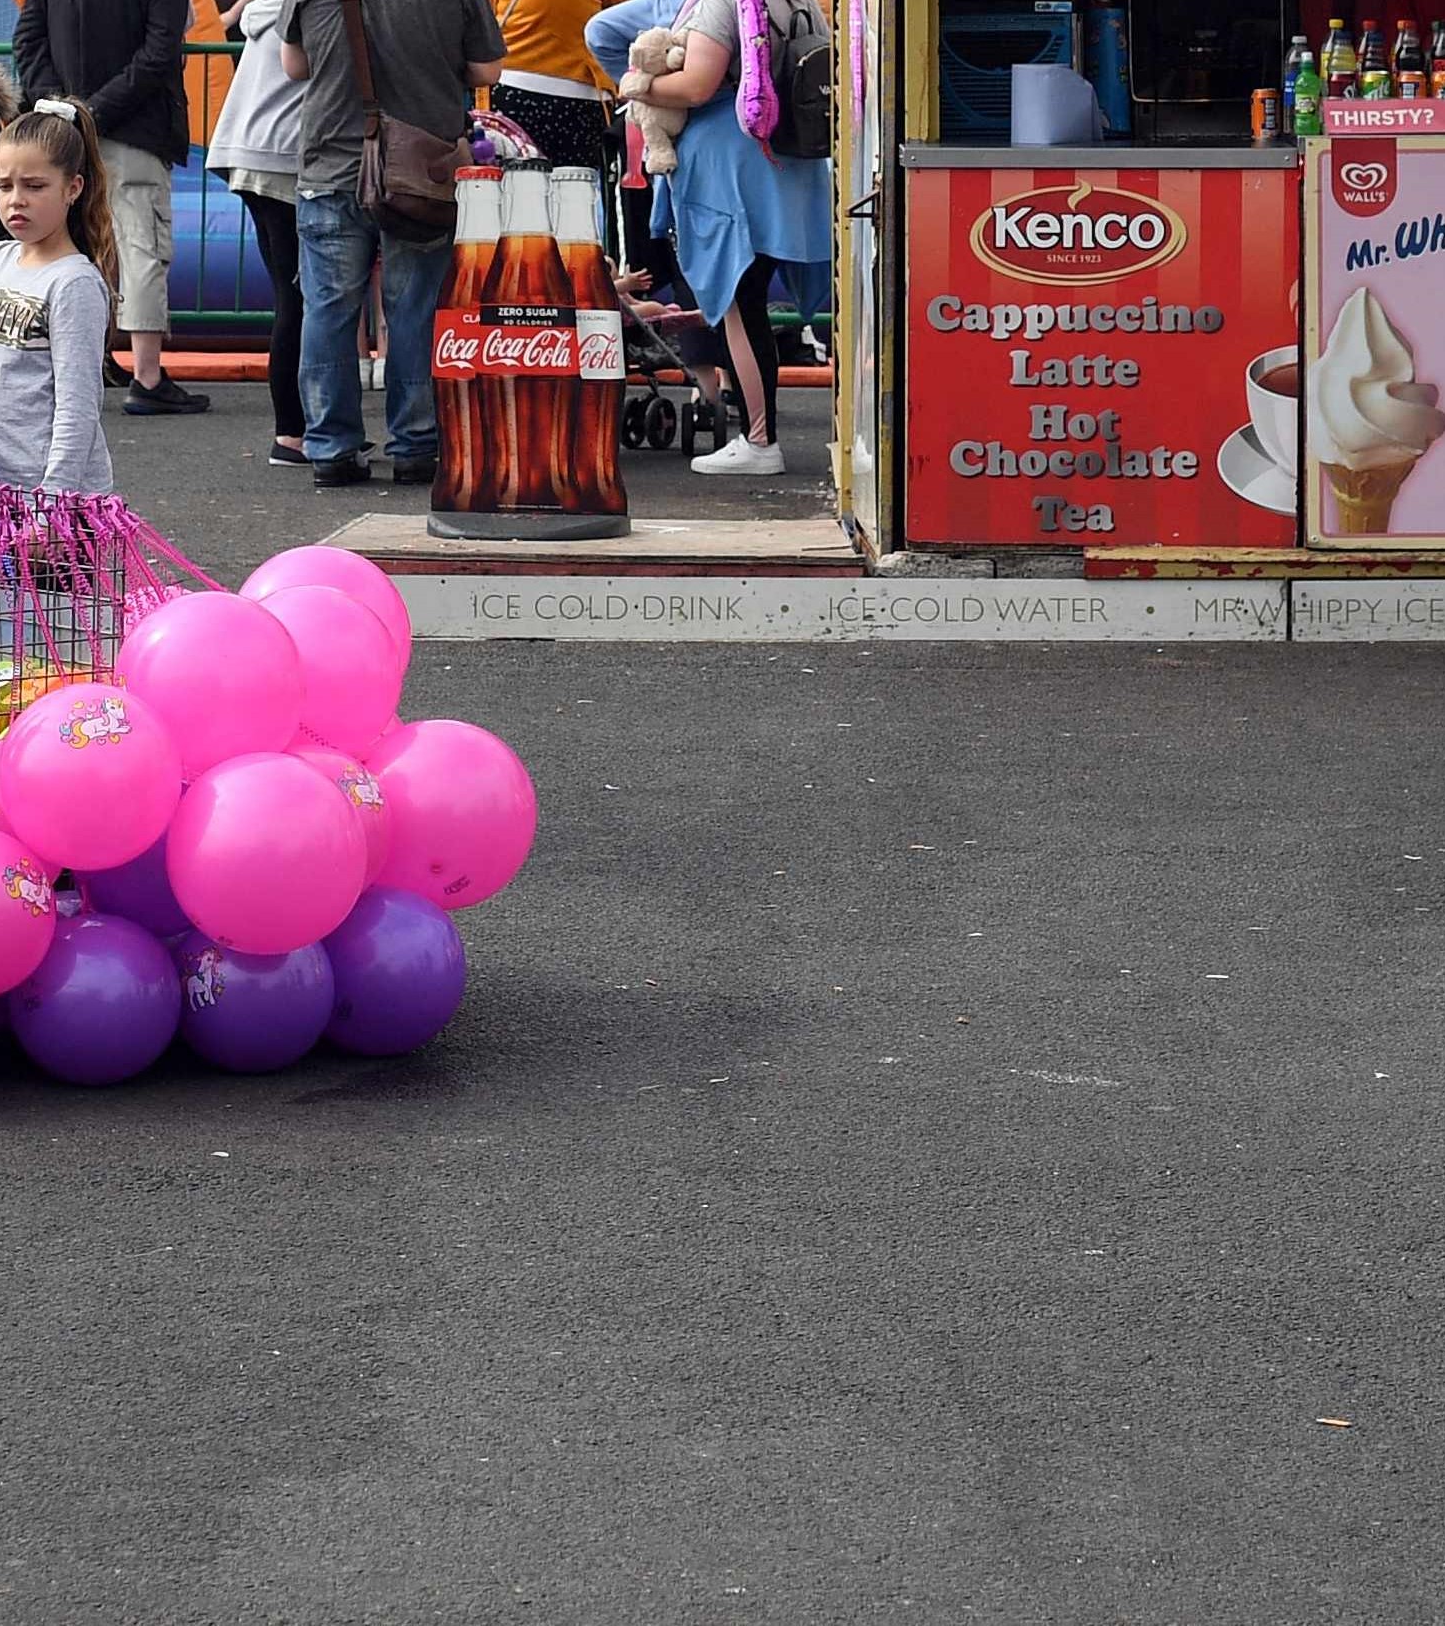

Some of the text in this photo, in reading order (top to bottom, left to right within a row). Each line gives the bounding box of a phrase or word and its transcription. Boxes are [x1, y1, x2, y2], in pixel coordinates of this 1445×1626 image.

[1329, 108, 1435, 127] THIRSTY?
[1343, 191, 1386, 203] WALL'S
[991, 205, 1167, 251] Kenco
[1046, 254, 1102, 264] SINCE 1923
[1345, 239, 1391, 272] Mr.
[498, 307, 559, 318] ZERO SUGAR
[926, 295, 1224, 340] Cappuccino
[1008, 350, 1140, 388] Latte
[1028, 404, 1122, 443] Hot
[949, 439, 1200, 479] Chocolate
[1031, 494, 1115, 533] Tea
[473, 595, 522, 621] ICE
[534, 594, 629, 621] COLD
[643, 595, 743, 622] DRINK
[829, 597, 877, 622] ICE
[890, 597, 986, 623] COLD
[994, 598, 1109, 624] WATER
[1396, 598, 1445, 624] ICE
